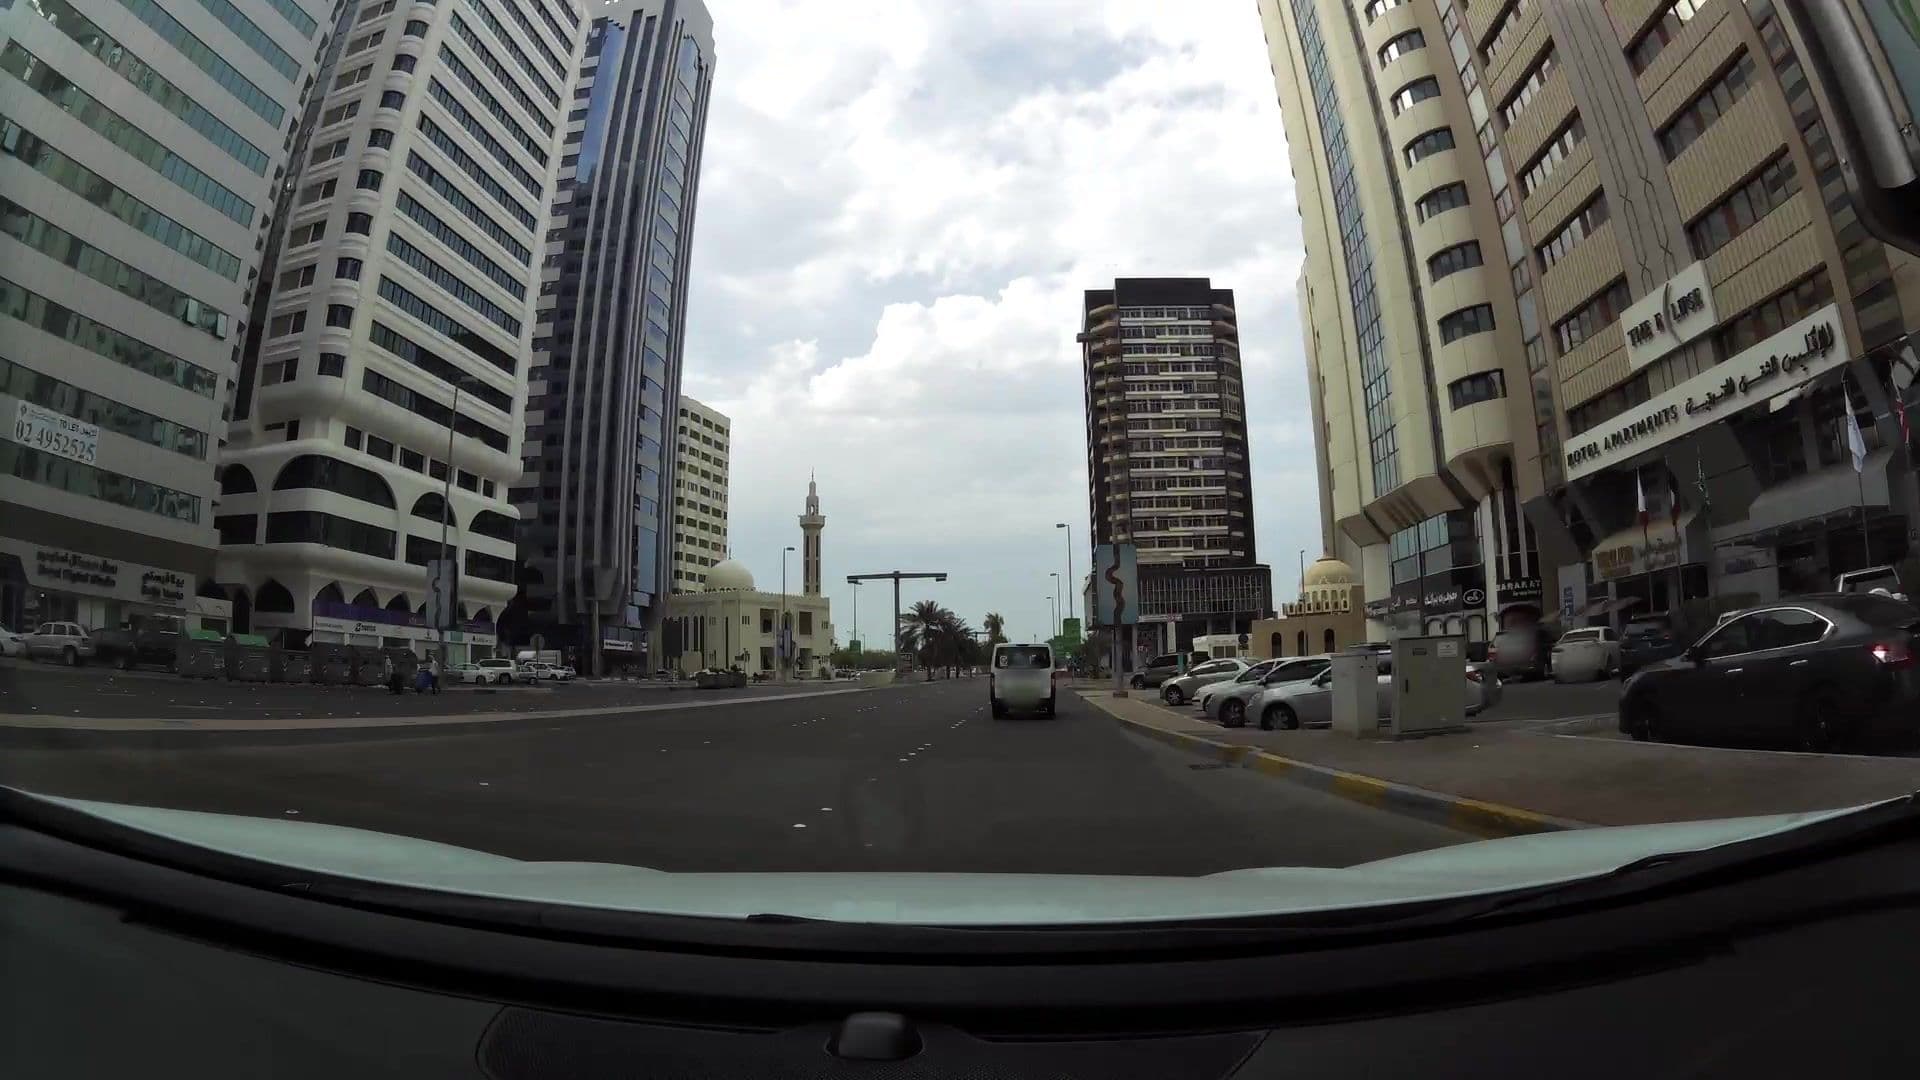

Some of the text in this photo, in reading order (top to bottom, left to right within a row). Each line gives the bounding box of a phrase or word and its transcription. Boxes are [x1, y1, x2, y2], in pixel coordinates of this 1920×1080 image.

[1626, 320, 1653, 346] THE
[16, 419, 96, 461] 02 4952525
[68, 423, 79, 432] LET
[1567, 404, 1679, 467] HOTEL APARTMENTS
